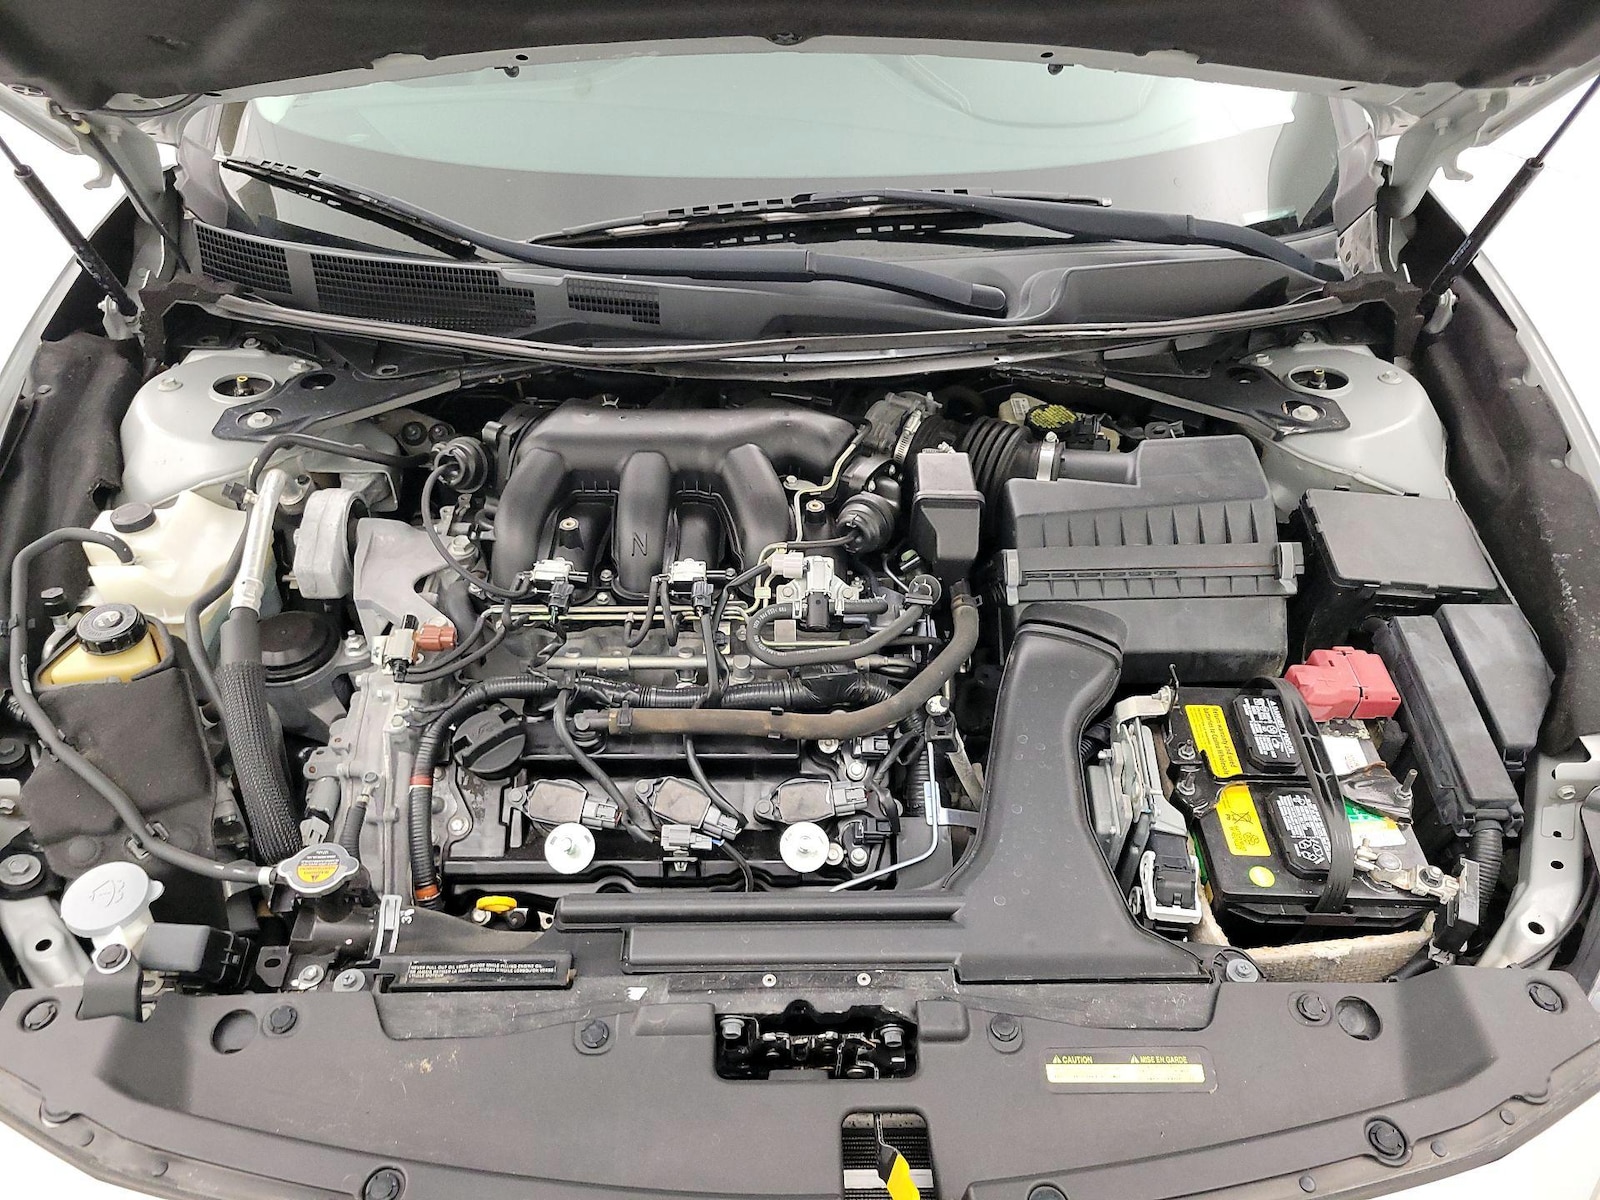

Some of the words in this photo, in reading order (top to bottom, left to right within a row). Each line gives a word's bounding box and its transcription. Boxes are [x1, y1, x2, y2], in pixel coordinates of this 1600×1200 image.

[631, 531, 648, 556] N
[1218, 724, 1229, 745] warranty
[1272, 706, 1286, 729] DANGER
[1283, 733, 1296, 755] POISON
[1203, 708, 1214, 728] batteries
[1217, 749, 1229, 775] Wholesale
[1225, 745, 1233, 756] and
[1228, 756, 1238, 768] used
[1062, 1055, 1093, 1064] CAUTION
[1140, 1056, 1155, 1064] MISE
[1155, 1056, 1165, 1064] EN
[1166, 1056, 1187, 1064] GARDE
